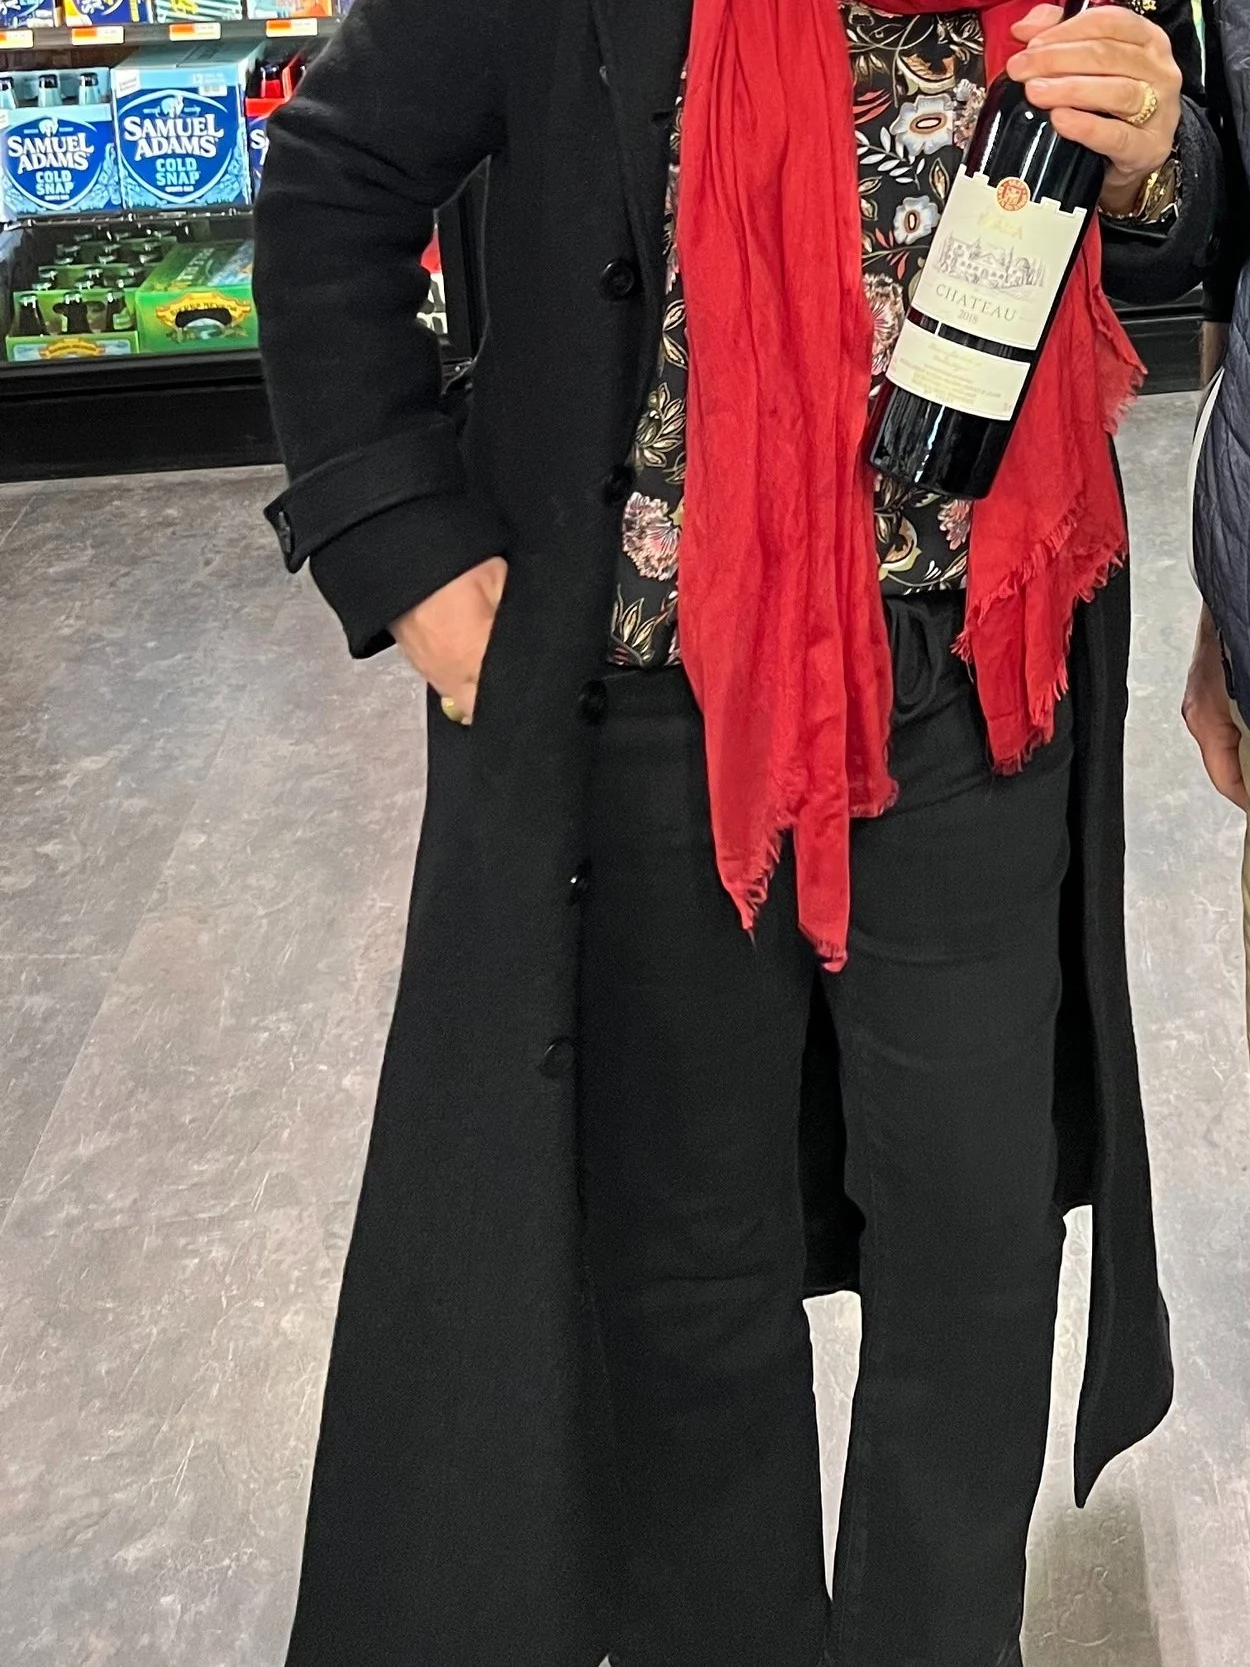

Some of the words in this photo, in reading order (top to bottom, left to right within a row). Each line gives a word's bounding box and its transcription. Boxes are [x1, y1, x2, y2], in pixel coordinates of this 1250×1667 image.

[123, 113, 224, 142] SAMUEL
[8, 132, 94, 158] SAMUEL
[134, 135, 218, 162] ADAMS
[17, 151, 90, 174] ADAMS
[156, 157, 197, 172] COLD
[35, 170, 71, 184] COLD
[156, 170, 200, 186] SNAP
[35, 182, 74, 196] SNAP
[936, 283, 1017, 322] CHATEAU
